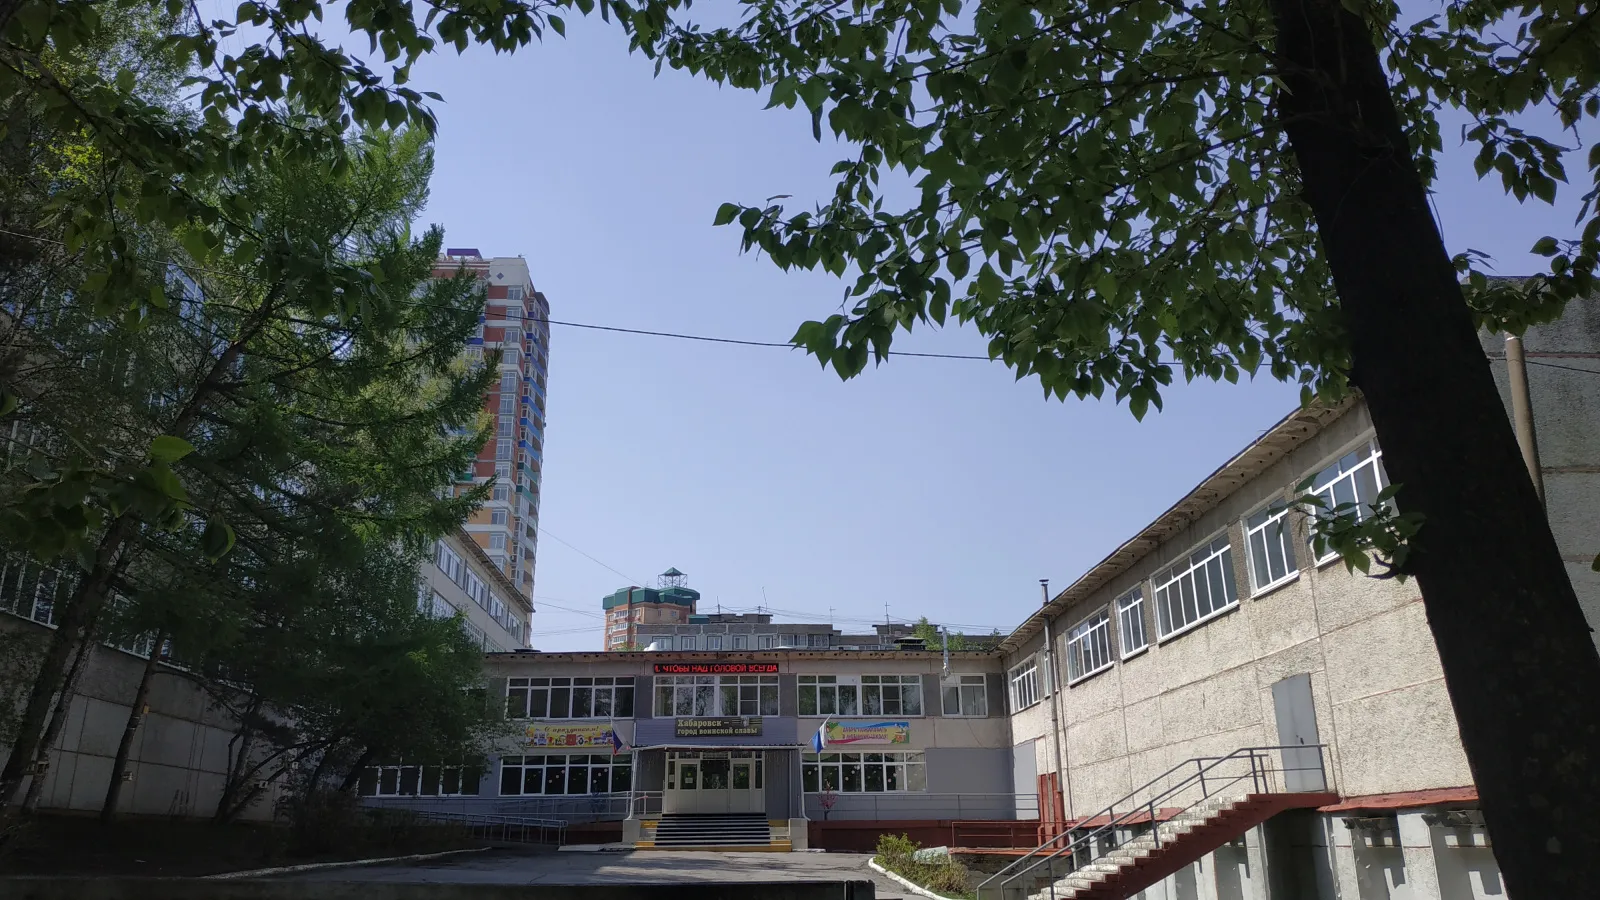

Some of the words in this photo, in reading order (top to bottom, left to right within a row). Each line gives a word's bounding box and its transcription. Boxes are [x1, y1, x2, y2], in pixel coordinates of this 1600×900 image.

[662, 664, 690, 673] ЧТОБЫ
[691, 664, 708, 673] НАД
[709, 663, 746, 673] ГОЛОВОЙ
[748, 664, 777, 673] ВСЕГДА
[677, 718, 722, 728] Хабаровск
[677, 728, 698, 736] город
[699, 726, 734, 735] воинской
[734, 727, 758, 735] славы
